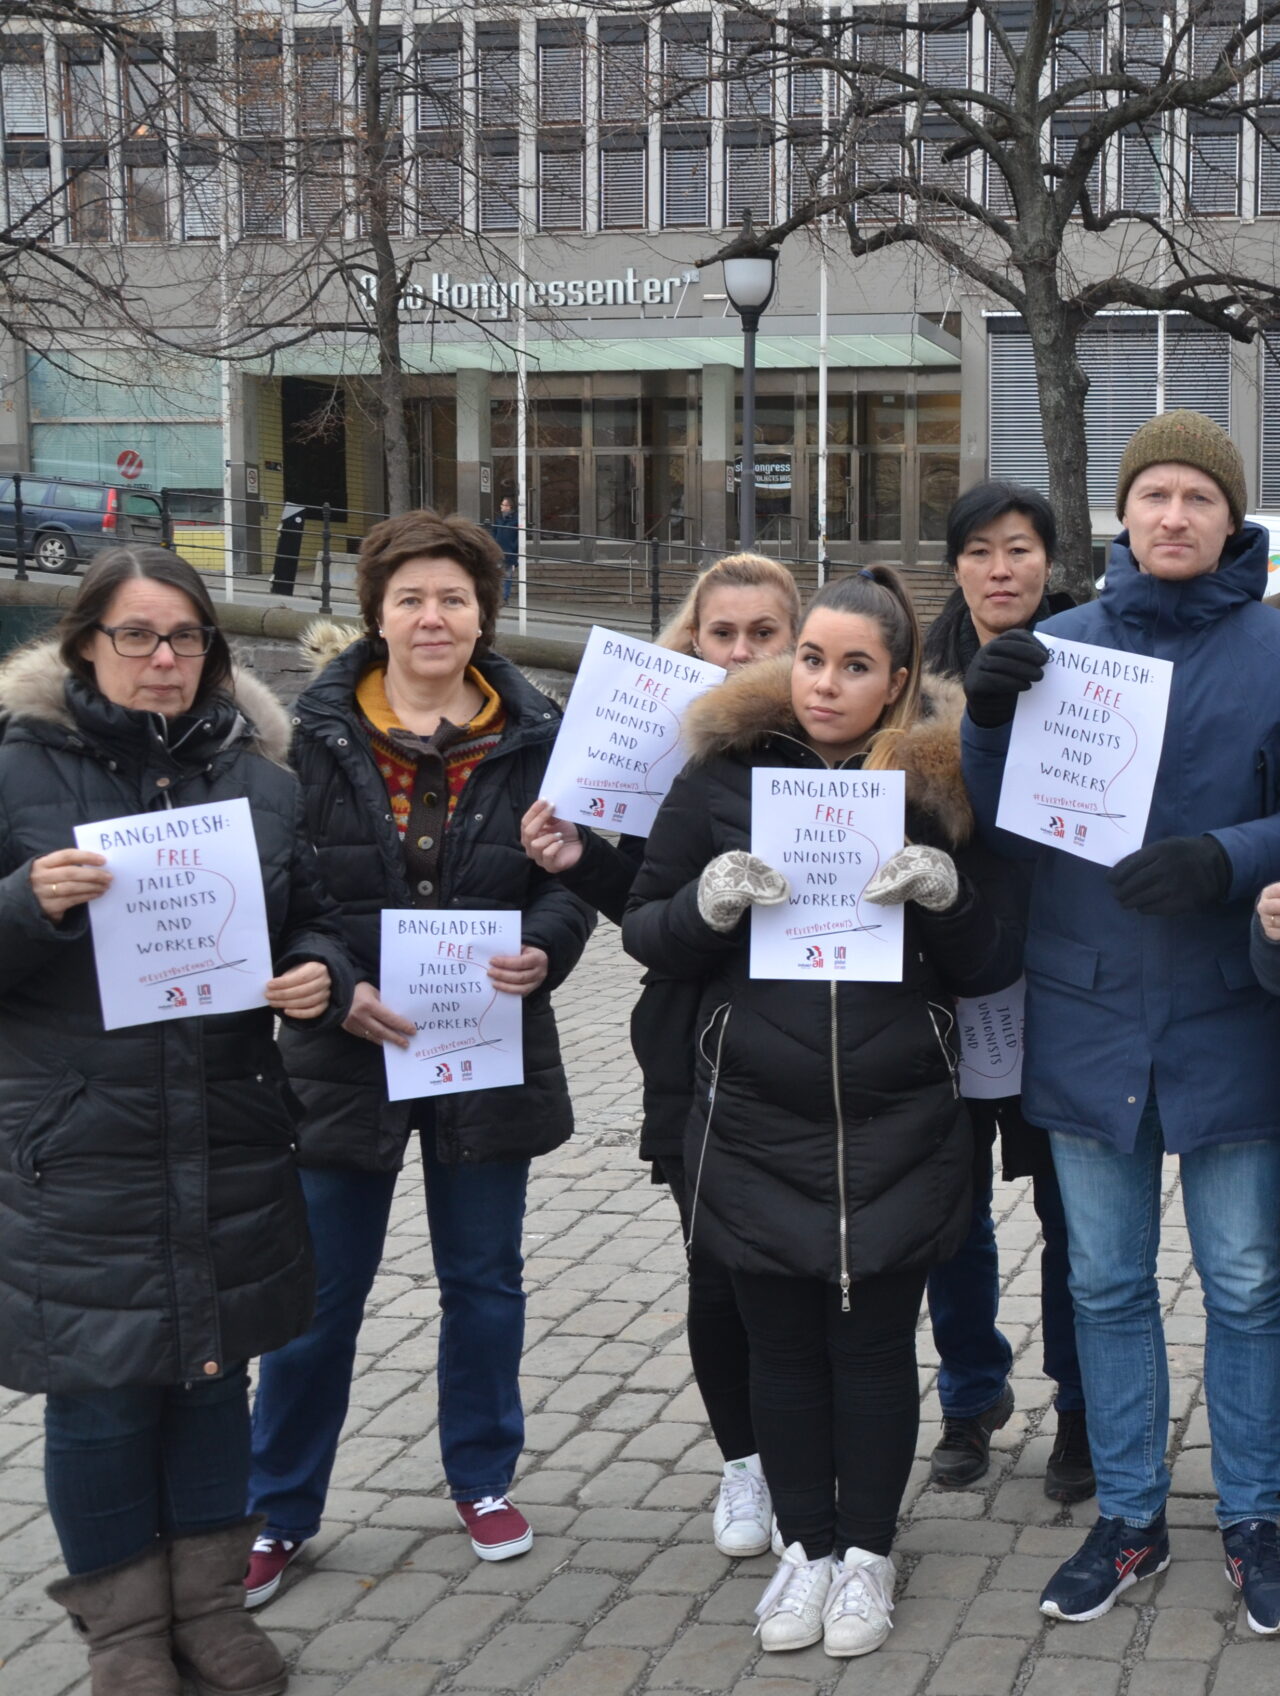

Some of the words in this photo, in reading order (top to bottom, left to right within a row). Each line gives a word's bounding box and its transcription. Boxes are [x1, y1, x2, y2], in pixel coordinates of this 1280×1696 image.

[603, 641, 704, 684] BANGLADESH:
[1046, 648, 1154, 684] BANGLADESH:
[635, 674, 671, 701] FREE
[1084, 681, 1122, 709] FREE
[611, 689, 658, 713] JAILED
[1058, 701, 1110, 723] JAILED
[596, 706, 666, 737] UNIONISTS
[609, 732, 638, 749] AND
[1044, 720, 1120, 749] UNIONISTS
[588, 746, 649, 774] WORKERS
[1061, 748, 1092, 765] AND
[1040, 762, 1106, 793] WORKERS
[771, 780, 886, 798] BANGLADESH:
[815, 804, 855, 826] FREE
[100, 815, 230, 850] BANGLADESH:
[794, 829, 846, 843] JAILED
[157, 849, 202, 866] FREE
[783, 852, 862, 864] UNIONISTS
[137, 871, 195, 894] JAILED
[806, 873, 837, 885] AND
[127, 891, 216, 913] UNIONISTS
[789, 895, 856, 906] WORKERS
[157, 918, 191, 931] AND
[398, 920, 502, 936] BANGLADESH:
[136, 936, 216, 954] WORKERS
[438, 941, 473, 959] FREE
[420, 963, 467, 977] JAILED
[410, 982, 482, 994] UNIONISTS
[432, 1002, 460, 1013] AND
[415, 1018, 478, 1030] WORKERS
[978, 1003, 1002, 1065] UNIONISTS
[997, 1006, 1016, 1048] JAILED
[963, 1026, 978, 1049] AND
